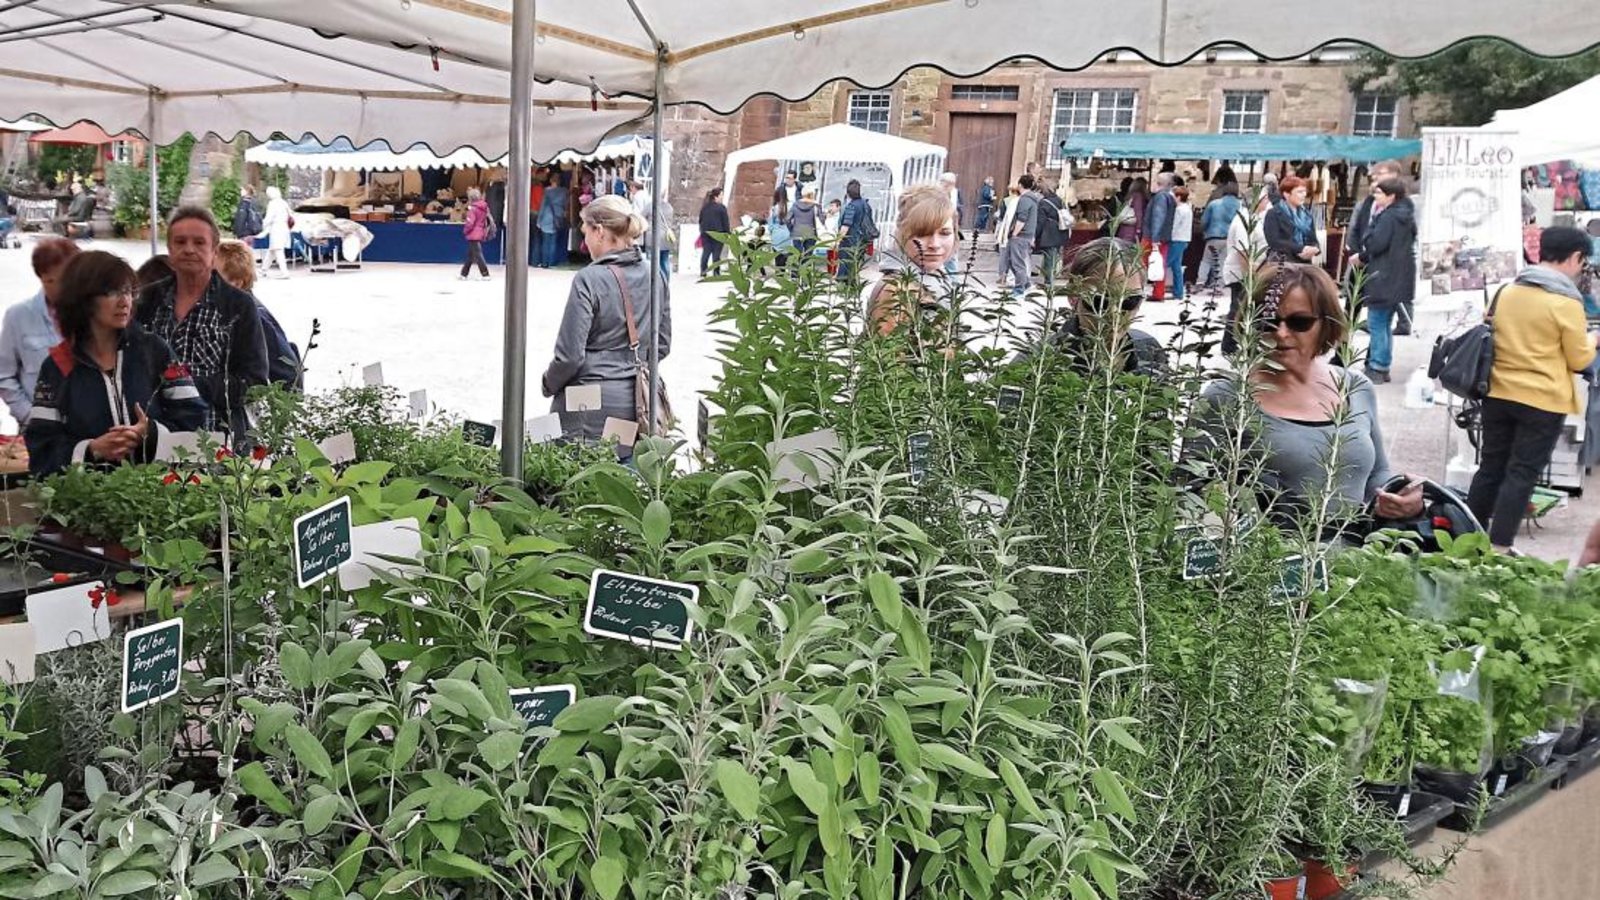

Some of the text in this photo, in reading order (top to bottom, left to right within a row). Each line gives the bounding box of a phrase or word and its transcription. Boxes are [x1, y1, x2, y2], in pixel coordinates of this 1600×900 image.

[307, 528, 337, 553] Salbei
[615, 593, 667, 609] Salbei
[134, 632, 169, 656] Salbei
[514, 699, 545, 711] rpur
[523, 710, 551, 722] lbei
